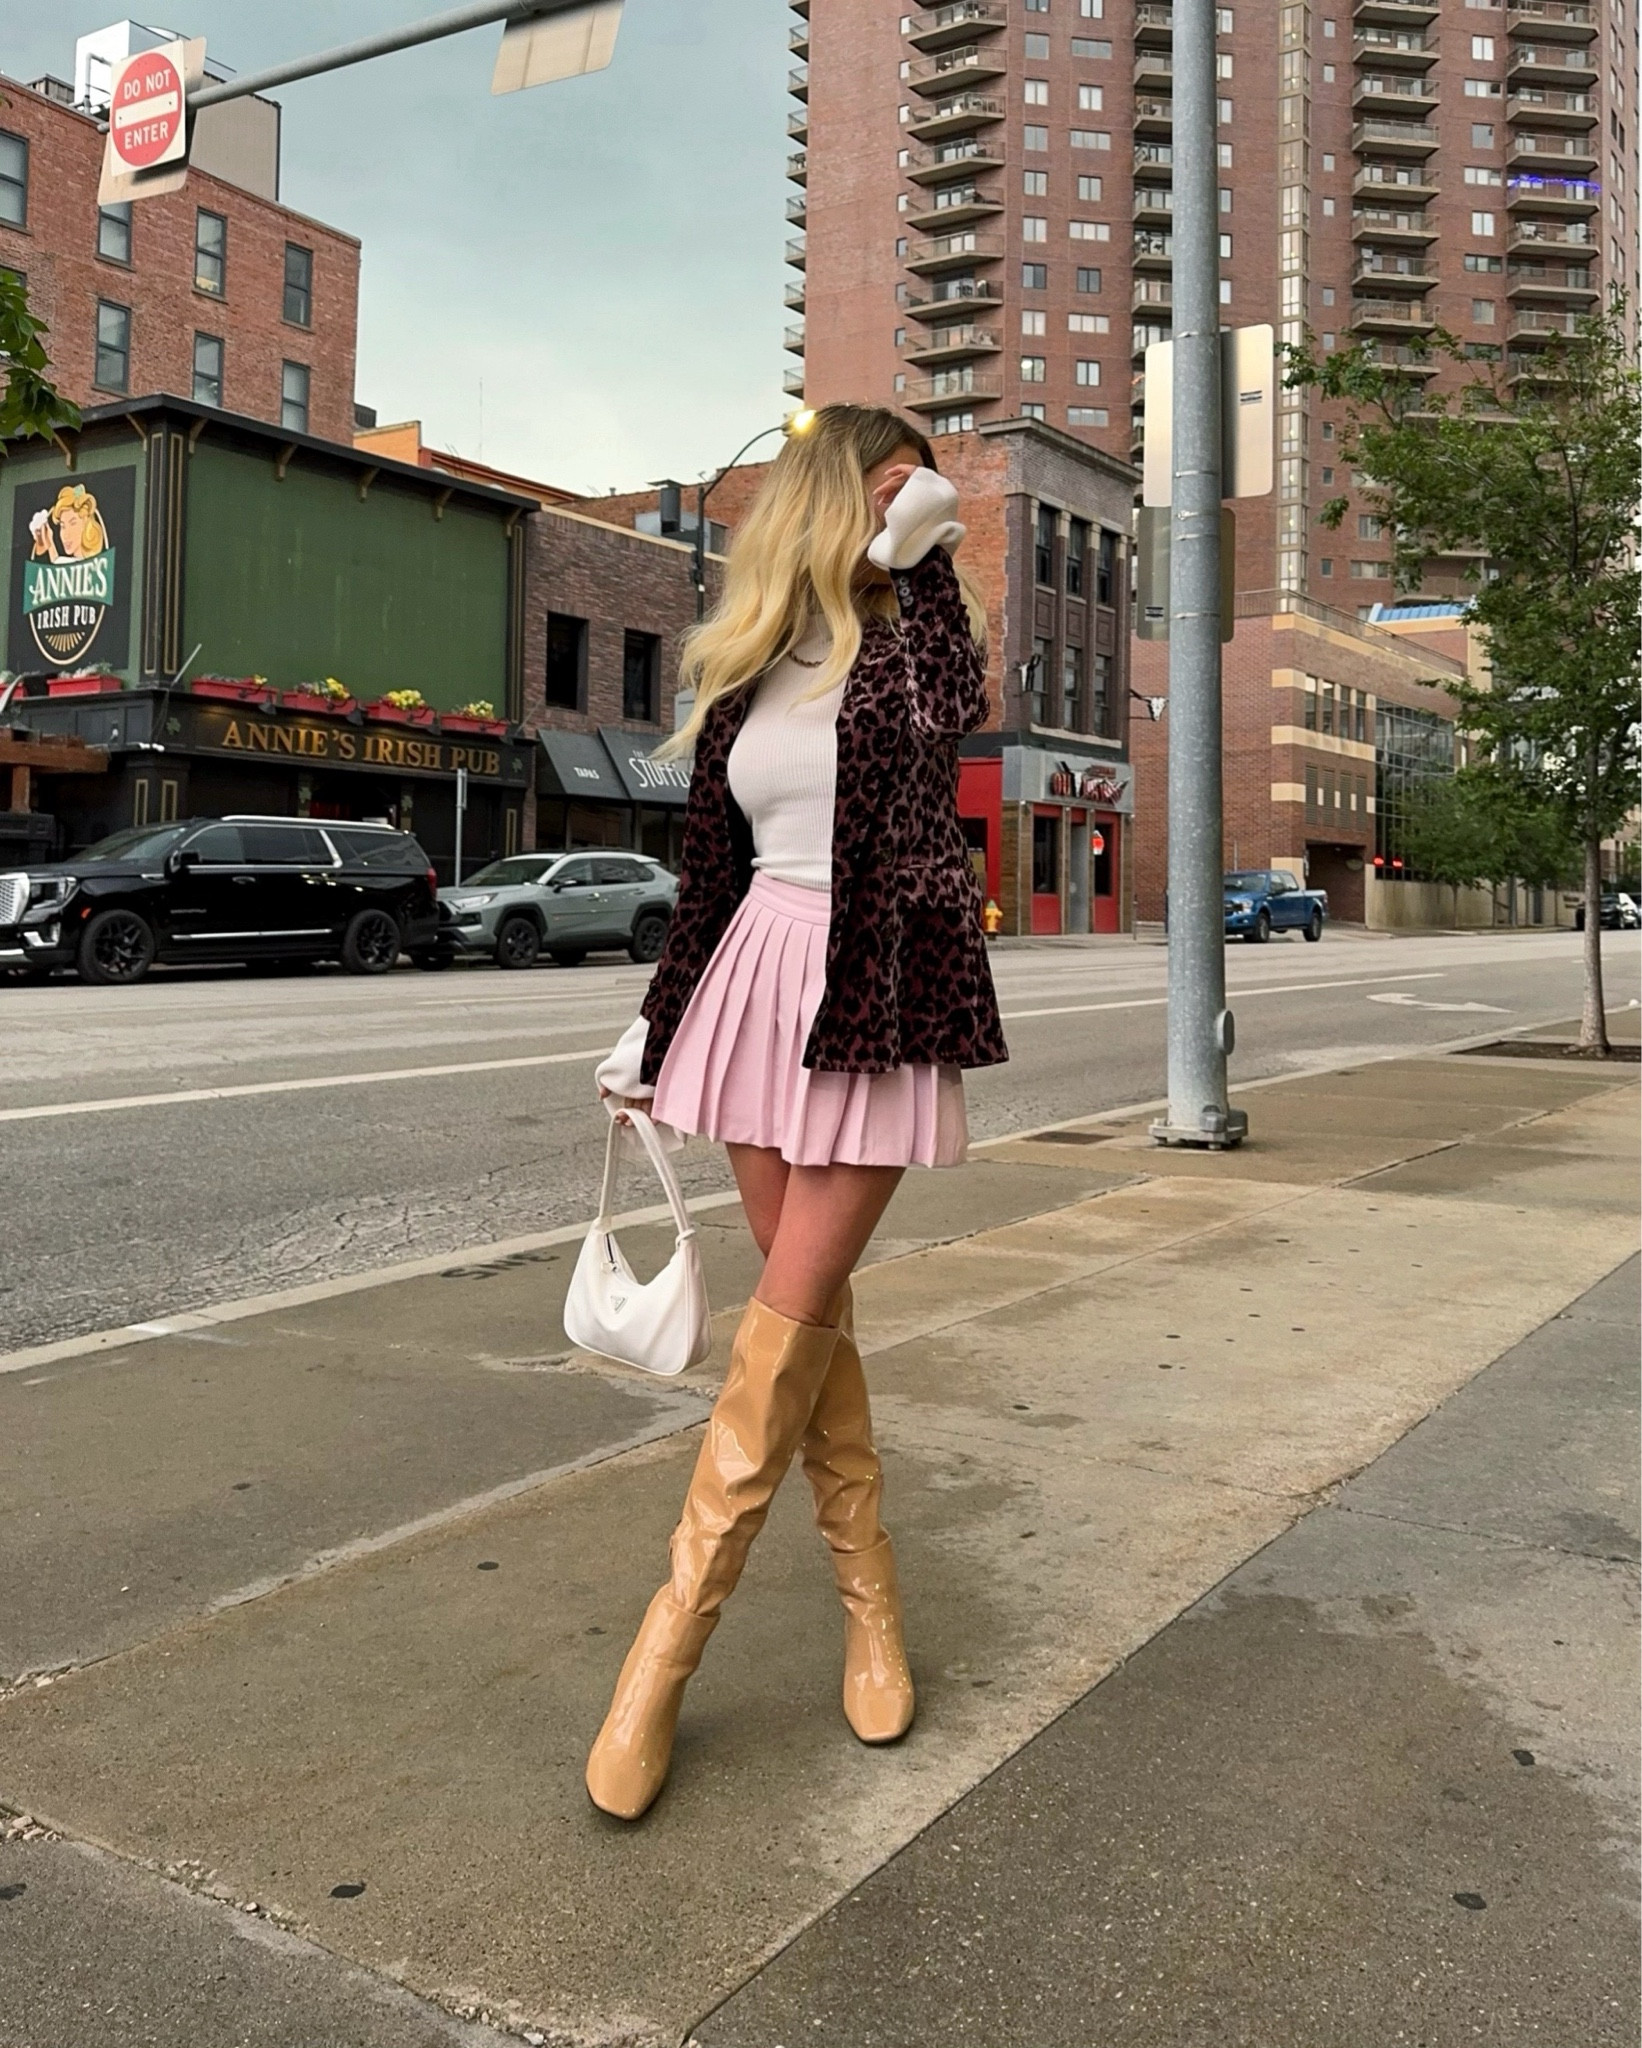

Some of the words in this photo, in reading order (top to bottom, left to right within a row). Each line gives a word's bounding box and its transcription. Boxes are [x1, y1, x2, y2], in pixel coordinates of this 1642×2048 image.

[124, 79, 141, 100] DO
[146, 69, 171, 93] NOT
[125, 121, 169, 150] ENTER
[29, 557, 108, 605] ANNIE'S
[37, 605, 70, 630] IRISH
[73, 604, 97, 626] PUB
[221, 720, 356, 759] ANNIE'S
[363, 736, 442, 769] IRISH
[449, 746, 500, 774] PUB
